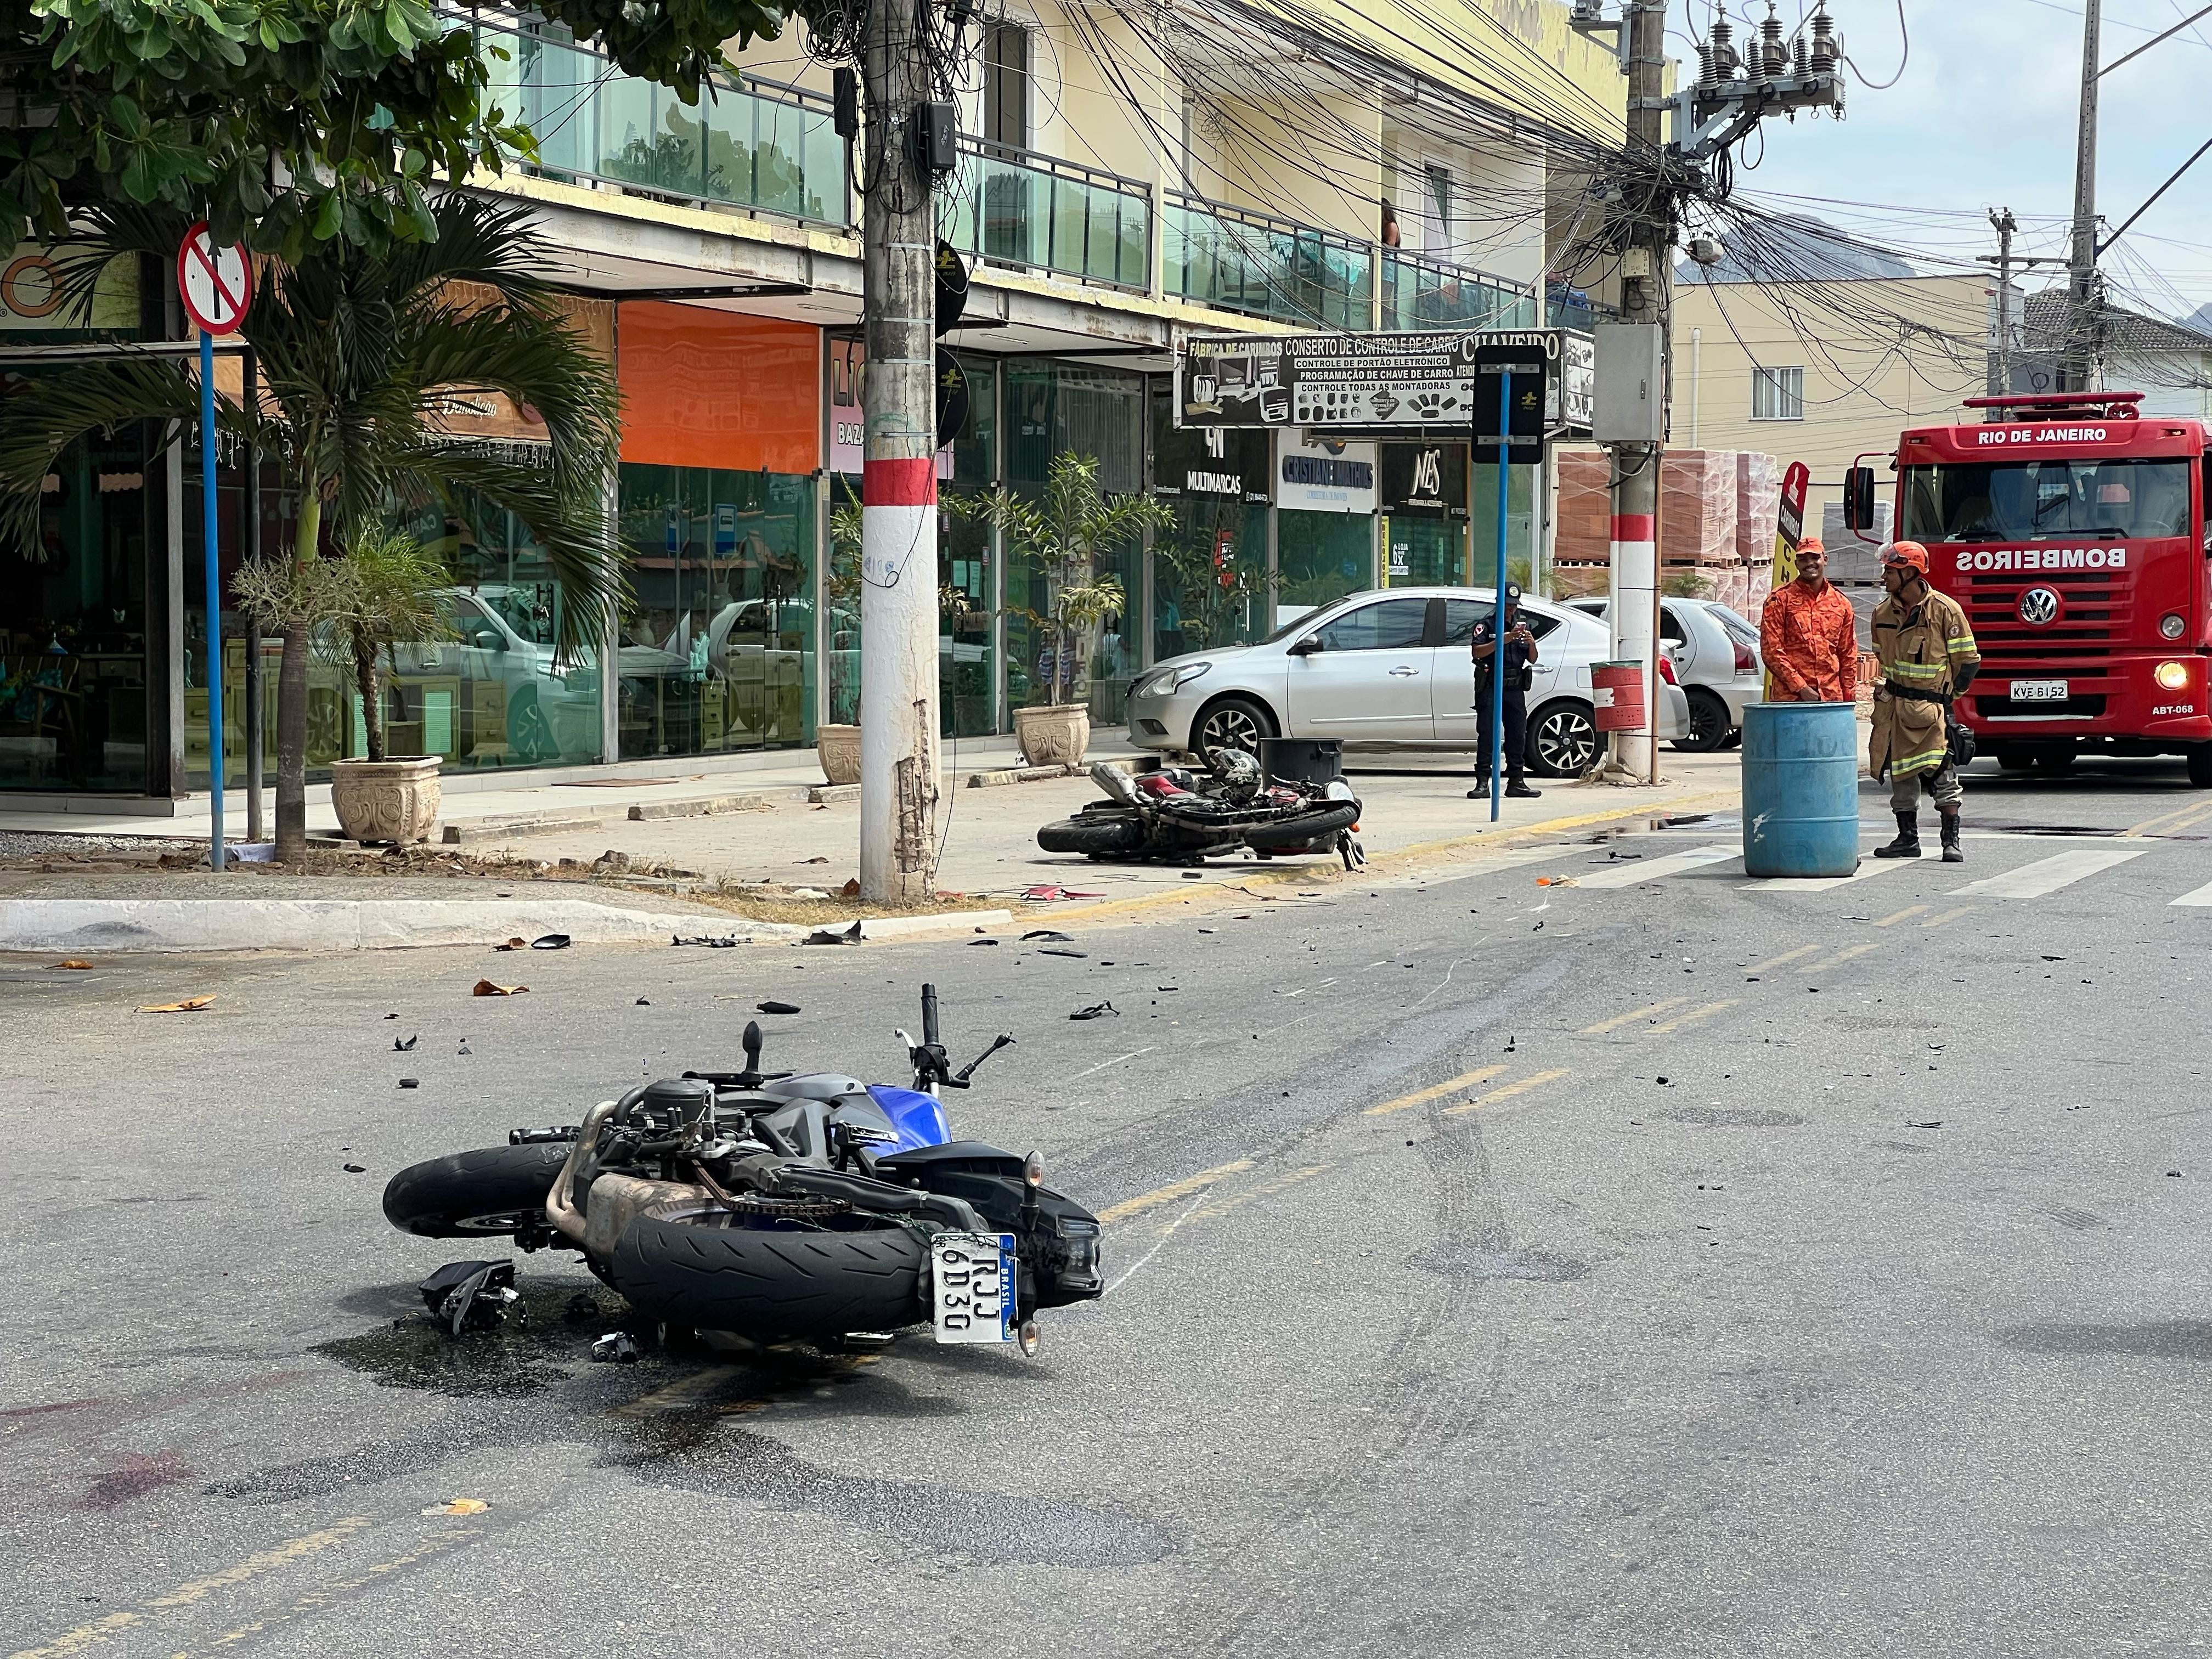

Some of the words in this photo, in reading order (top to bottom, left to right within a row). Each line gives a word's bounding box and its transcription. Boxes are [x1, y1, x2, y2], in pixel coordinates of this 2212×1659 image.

[1226, 343, 1237, 355] DE
[1285, 337, 1338, 356] CONSERTO
[1340, 338, 1352, 355] DE
[1355, 337, 1407, 354] CONTROLE
[1409, 336, 1422, 353] DE
[1424, 335, 1459, 353] CARRO
[1296, 359, 1341, 368] CONTROLE
[1357, 357, 1391, 366] PORTÃO
[1393, 356, 1448, 366] ELETRÔNICO
[1300, 369, 1364, 381] PROGRAMAÇÃO
[1367, 370, 1378, 379] DE
[1380, 369, 1409, 379] CHAVE
[1412, 369, 1422, 379] DE
[1424, 368, 1454, 379] CARRO
[1301, 383, 1347, 392] CONTROLE
[1349, 382, 1376, 391] TODAS
[1378, 382, 1390, 391] AS
[1392, 381, 1451, 391] MONTADORAS
[1978, 431, 2006, 444] RIO
[2011, 430, 2032, 443] DE
[2036, 428, 2107, 442] JANEIRO
[1286, 455, 1334, 485] CRISTIANE
[1187, 470, 1242, 495] MULTIMARCAS
[2152, 705, 2193, 715] ABT-068
[972, 1259, 1000, 1320] RJJ
[1001, 1267, 1011, 1308] BRASIL
